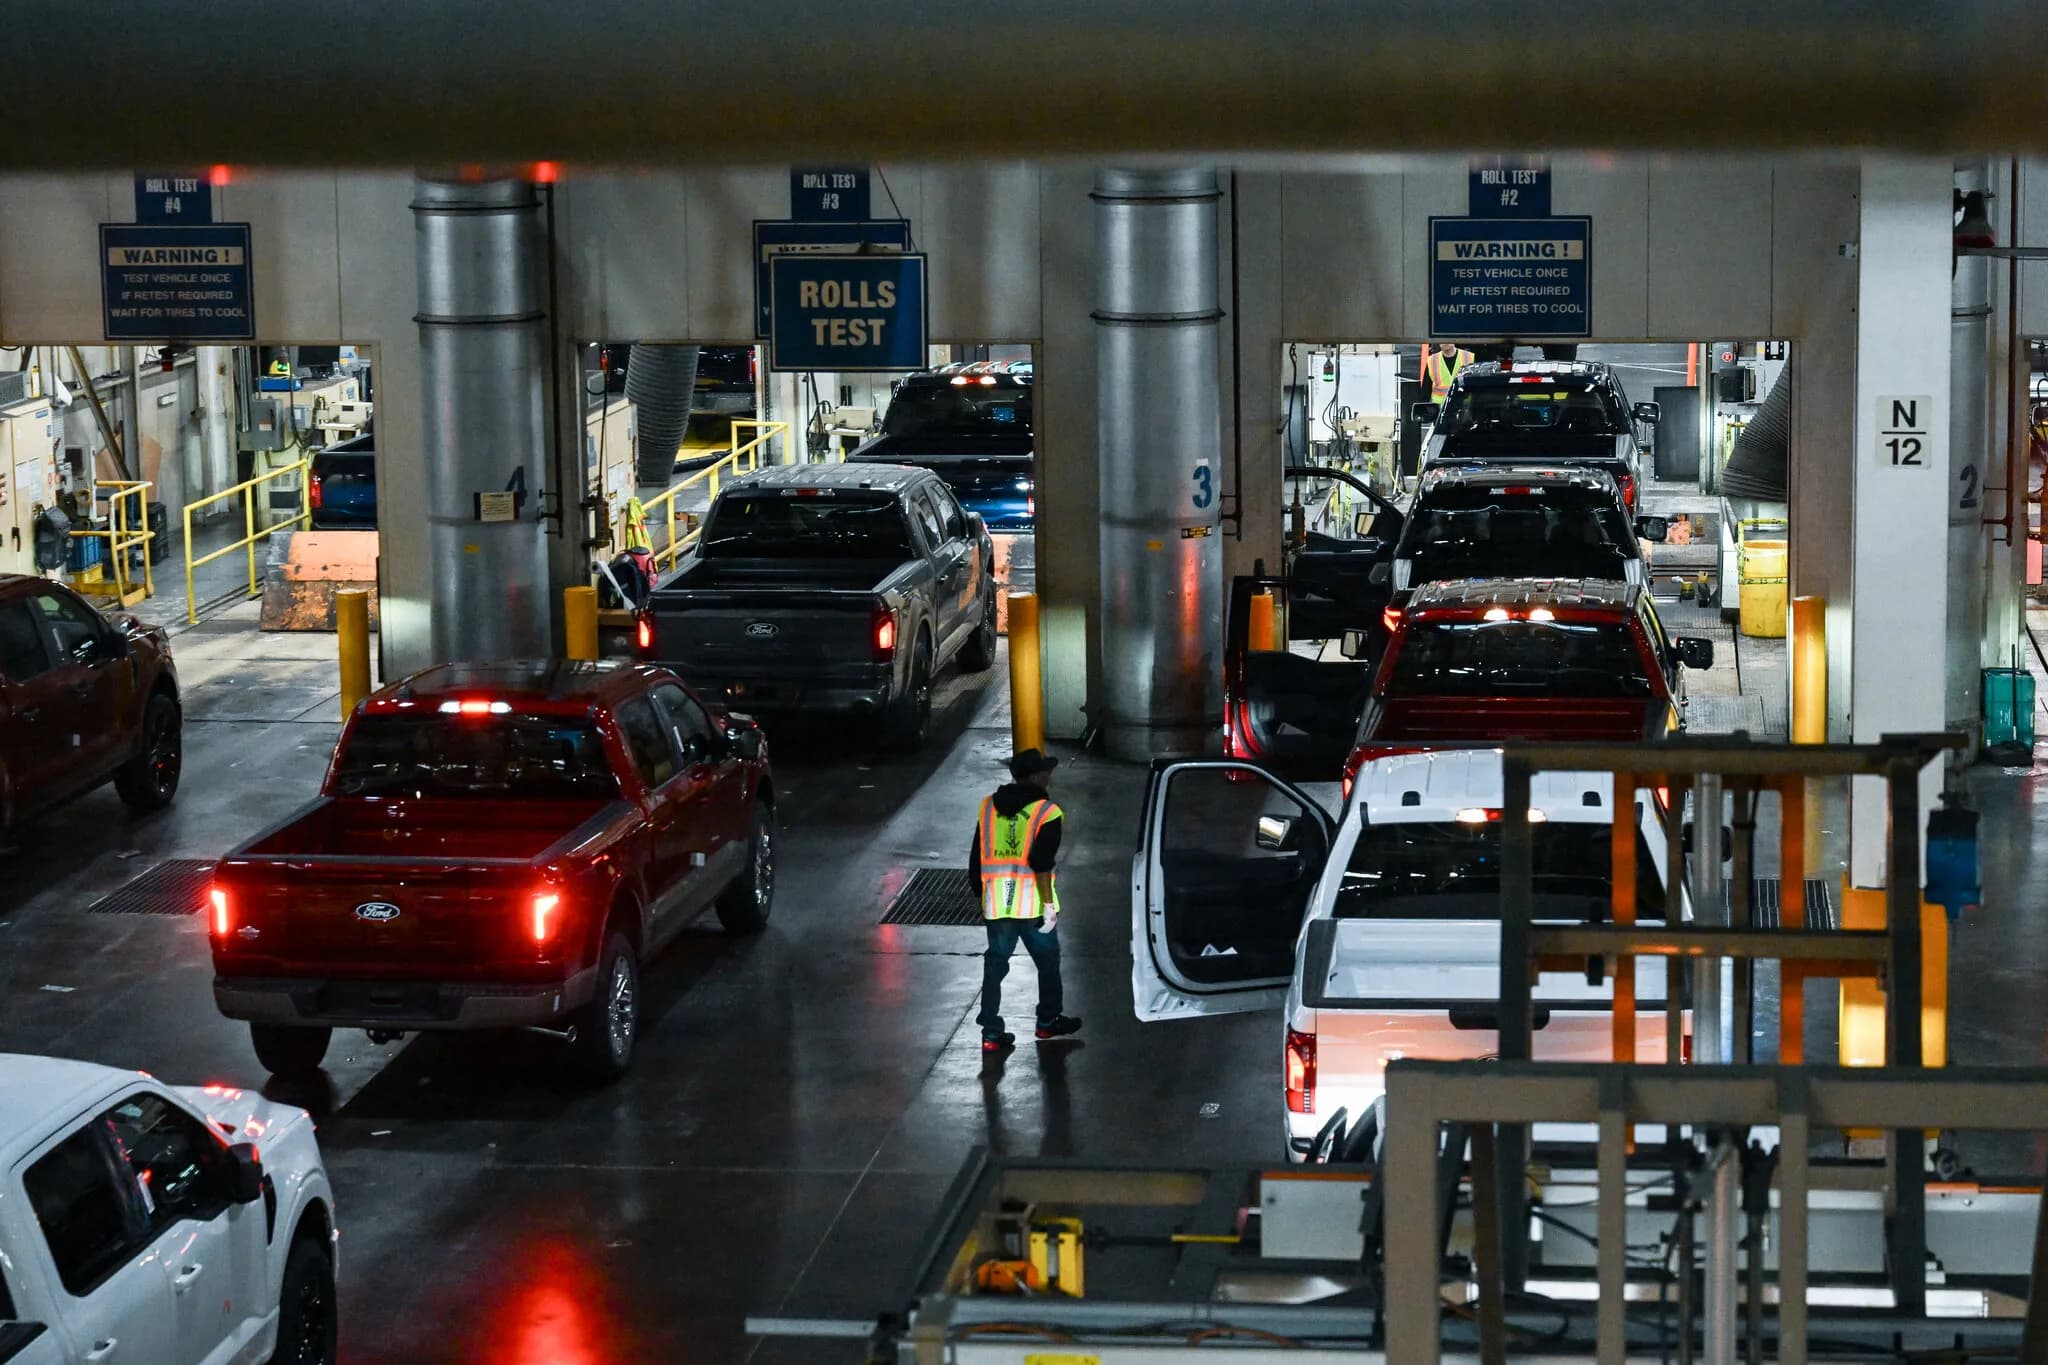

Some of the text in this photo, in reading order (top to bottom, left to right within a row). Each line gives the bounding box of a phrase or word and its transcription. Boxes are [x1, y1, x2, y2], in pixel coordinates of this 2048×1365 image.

[832, 173, 856, 189] TEST
[1481, 169, 1537, 185] ROLL TEST
[145, 178, 198, 193] ROLL TEST
[821, 192, 840, 210] #3
[1500, 188, 1519, 206] #2
[164, 197, 181, 214] #4
[123, 249, 218, 263] WARNING
[1454, 242, 1556, 258] WARNING
[123, 273, 232, 283] TEST VEHICLE ONCE
[1452, 268, 1569, 278] TEST VEHICLE ONCE
[121, 291, 233, 300] IF RETEST REQUIRED
[800, 280, 897, 309] ROLLS
[1450, 286, 1571, 296] IF RETEST REQUIRED
[111, 308, 246, 318] WAIT FOR TIRES TO COOL
[1437, 304, 1584, 314] WAIT FOR TIRES TO COOL
[811, 318, 886, 346] TEST
[1892, 400, 1916, 428] N
[1885, 438, 1922, 466] 12
[504, 465, 528, 508] 4
[1192, 465, 1213, 509] 3
[1959, 463, 1978, 509] 2
[362, 903, 394, 919] Ford
